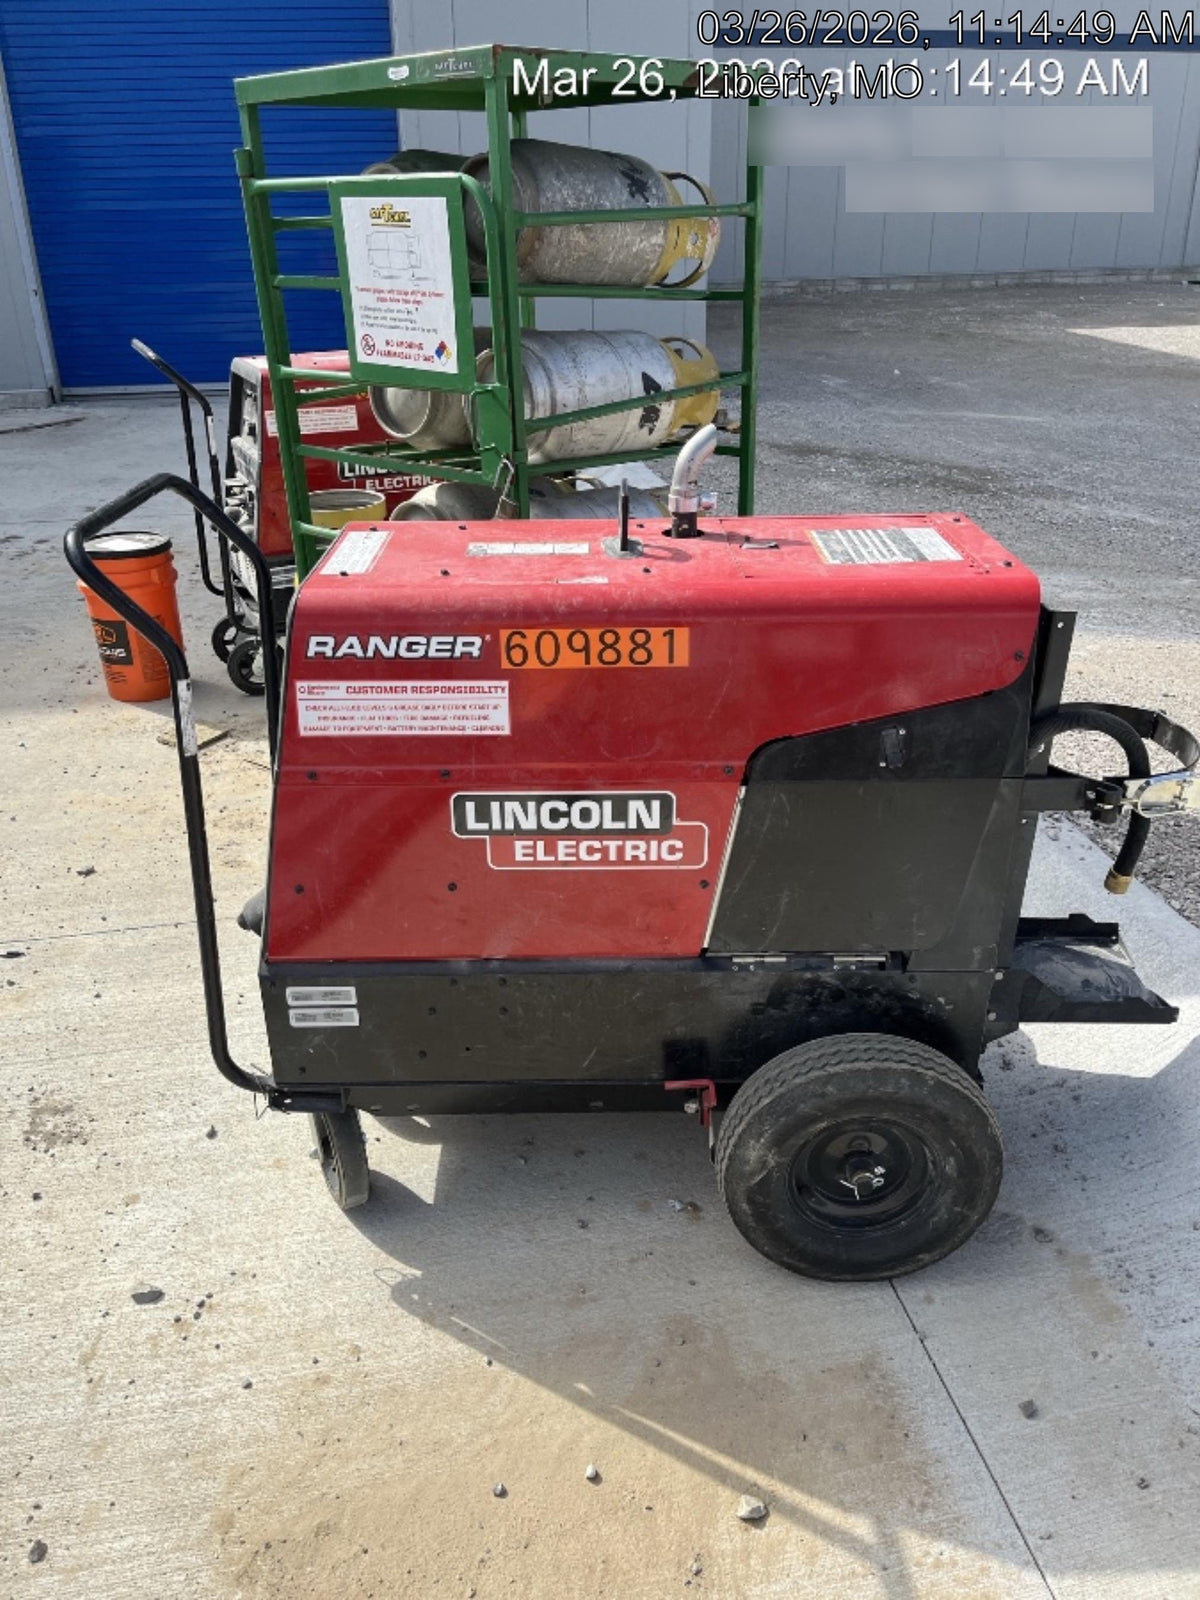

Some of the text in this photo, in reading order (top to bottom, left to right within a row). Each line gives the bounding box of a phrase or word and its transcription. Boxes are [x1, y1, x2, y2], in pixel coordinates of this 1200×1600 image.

[306, 635, 483, 658] RANGER
[505, 628, 675, 667] 609881
[345, 685, 408, 694] CUSTOMER
[411, 685, 507, 694] RESPONSIBILITY
[464, 799, 661, 830] LINCOLN
[514, 840, 684, 861] ELECTRIC
